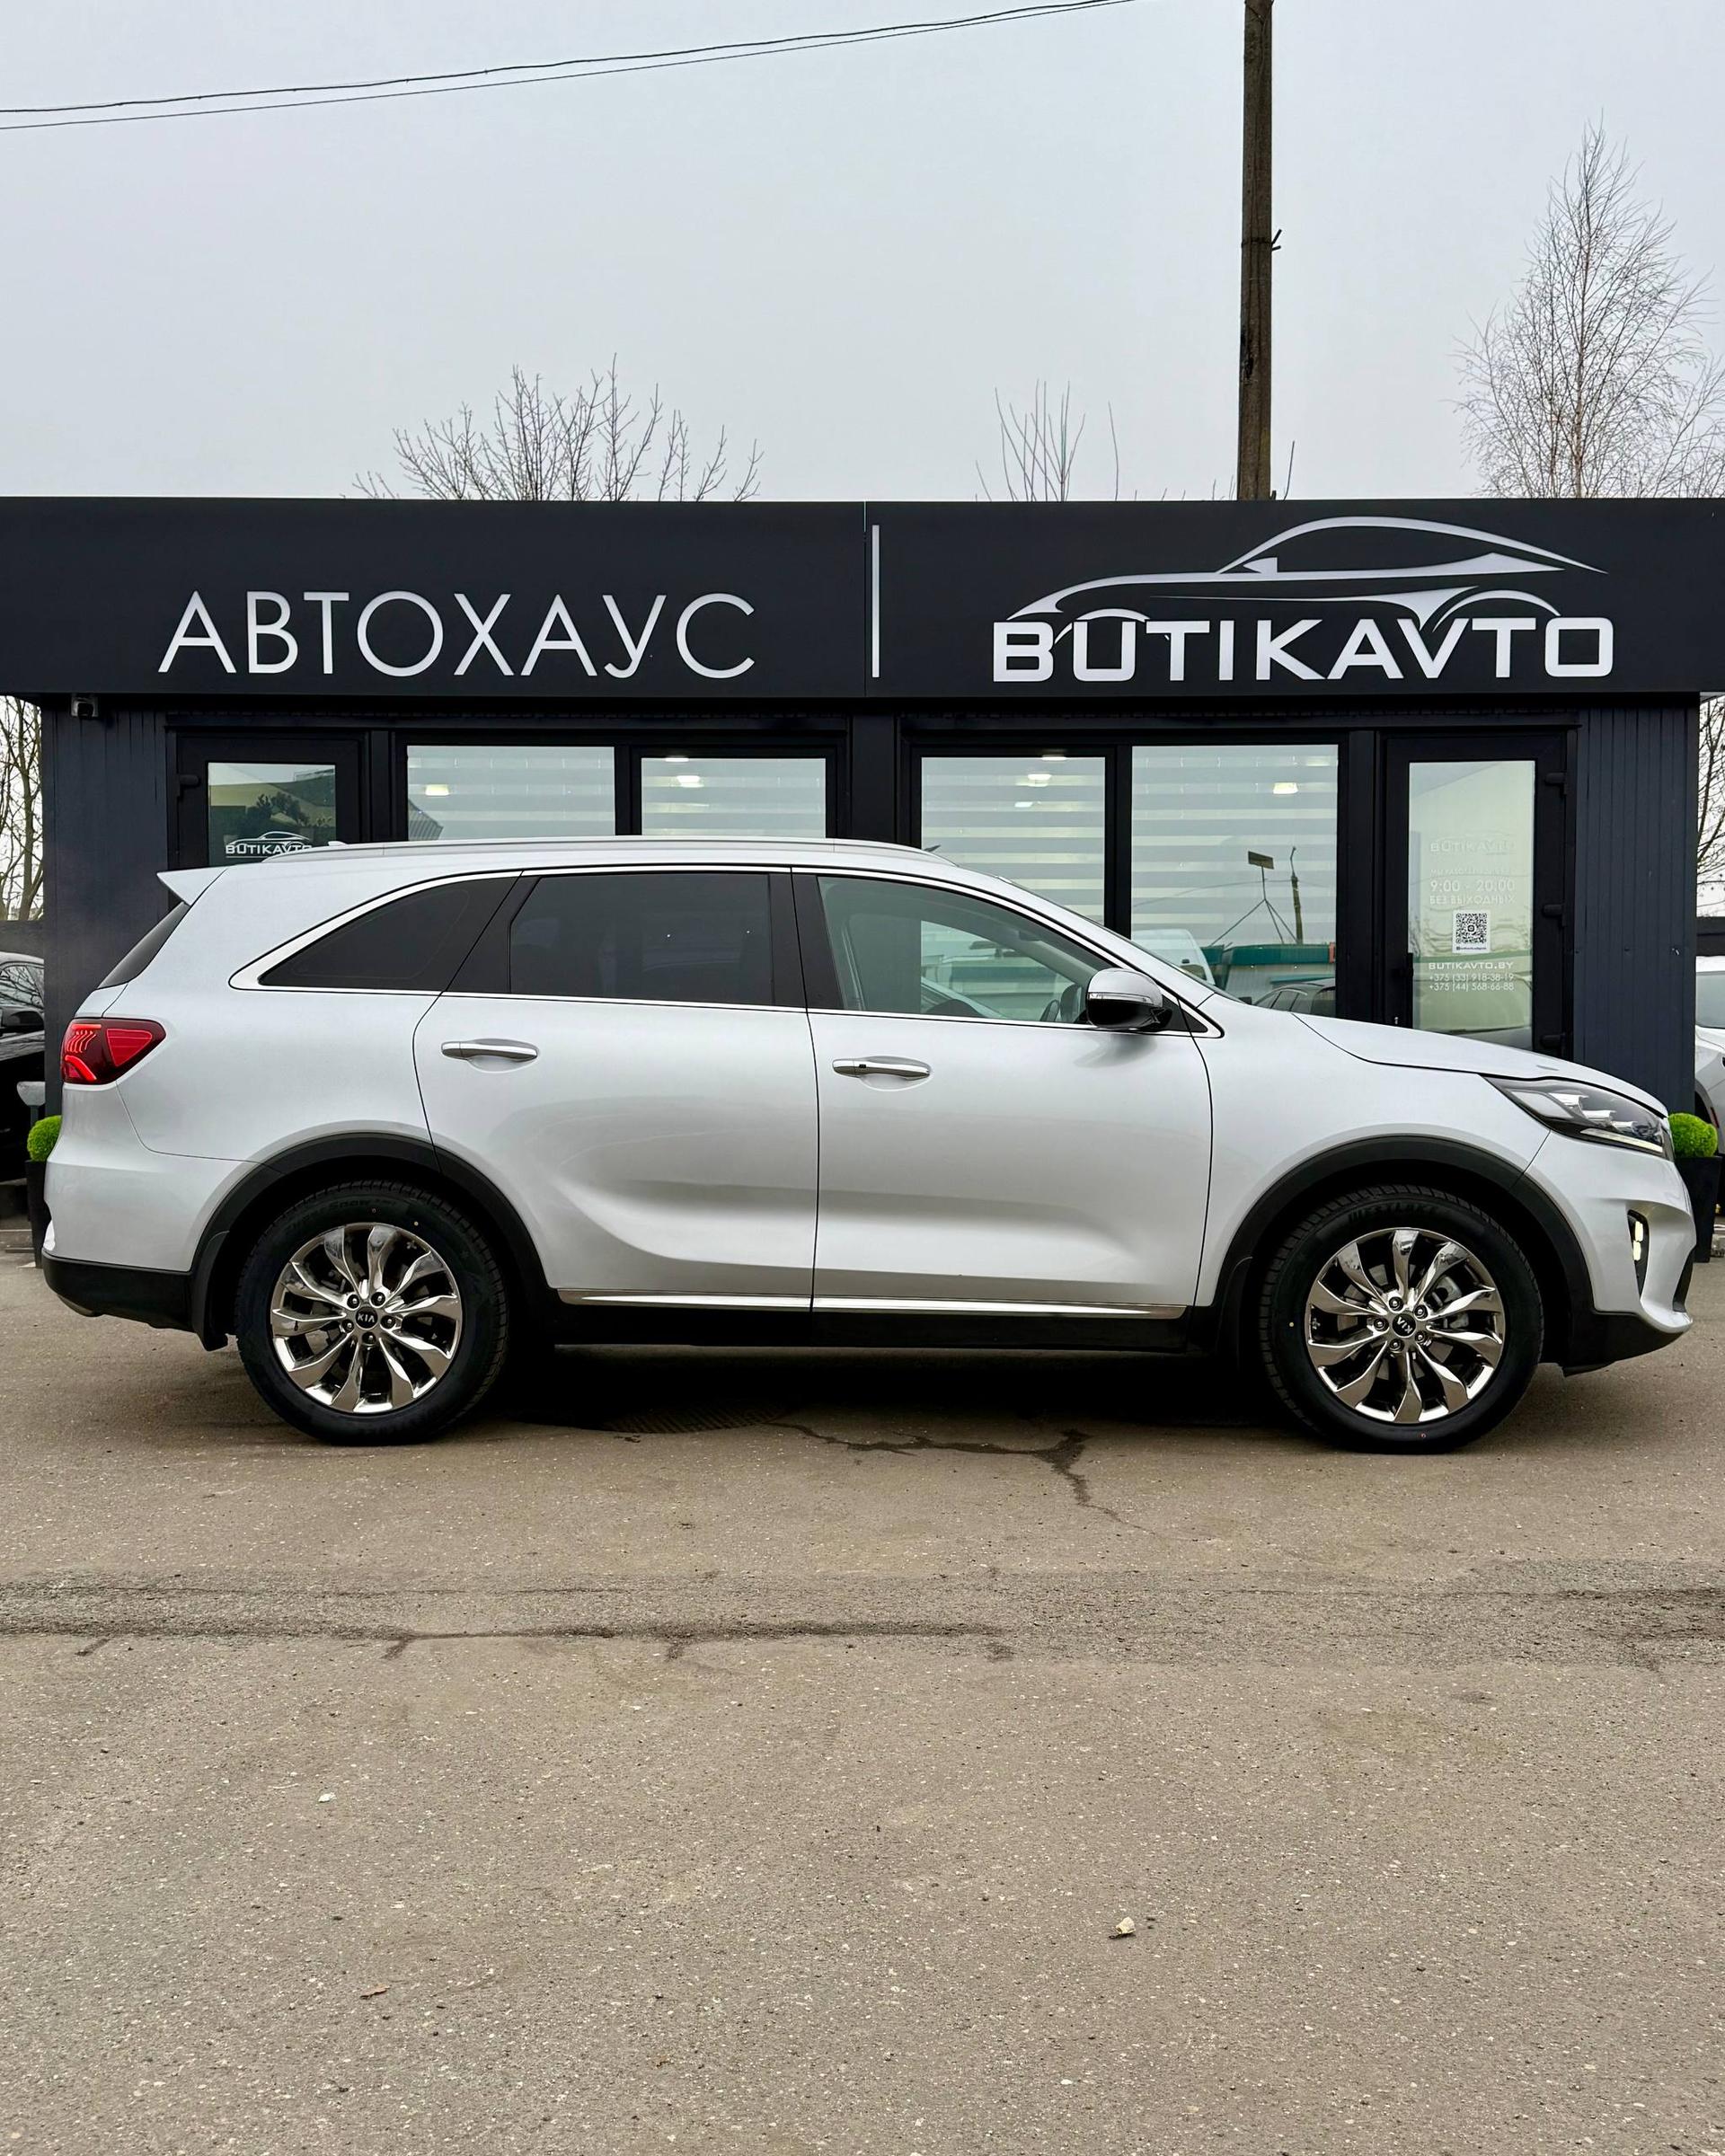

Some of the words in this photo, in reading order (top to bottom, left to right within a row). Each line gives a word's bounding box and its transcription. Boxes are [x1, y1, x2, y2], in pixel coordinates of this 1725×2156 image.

[157, 590, 755, 679] АВТОХАУС
[993, 616, 1614, 683] BUTIKAVTO
[1430, 879, 1460, 892] 9:00
[1429, 895, 1446, 905] БЕЗ
[1450, 895, 1517, 906] ВЫХОДНЫХ
[1429, 962, 1514, 970] BUTIKAVTO.BY
[1429, 973, 1449, 981] +375
[1452, 973, 1469, 983] (33)
[1472, 973, 1514, 982] 918-38-19
[1429, 983, 1449, 991] +375
[1452, 982, 1469, 992] (44)
[1472, 982, 1515, 991] 568-66-88
[357, 1312, 375, 1322] KIA
[1397, 1316, 1413, 1334] KIA
